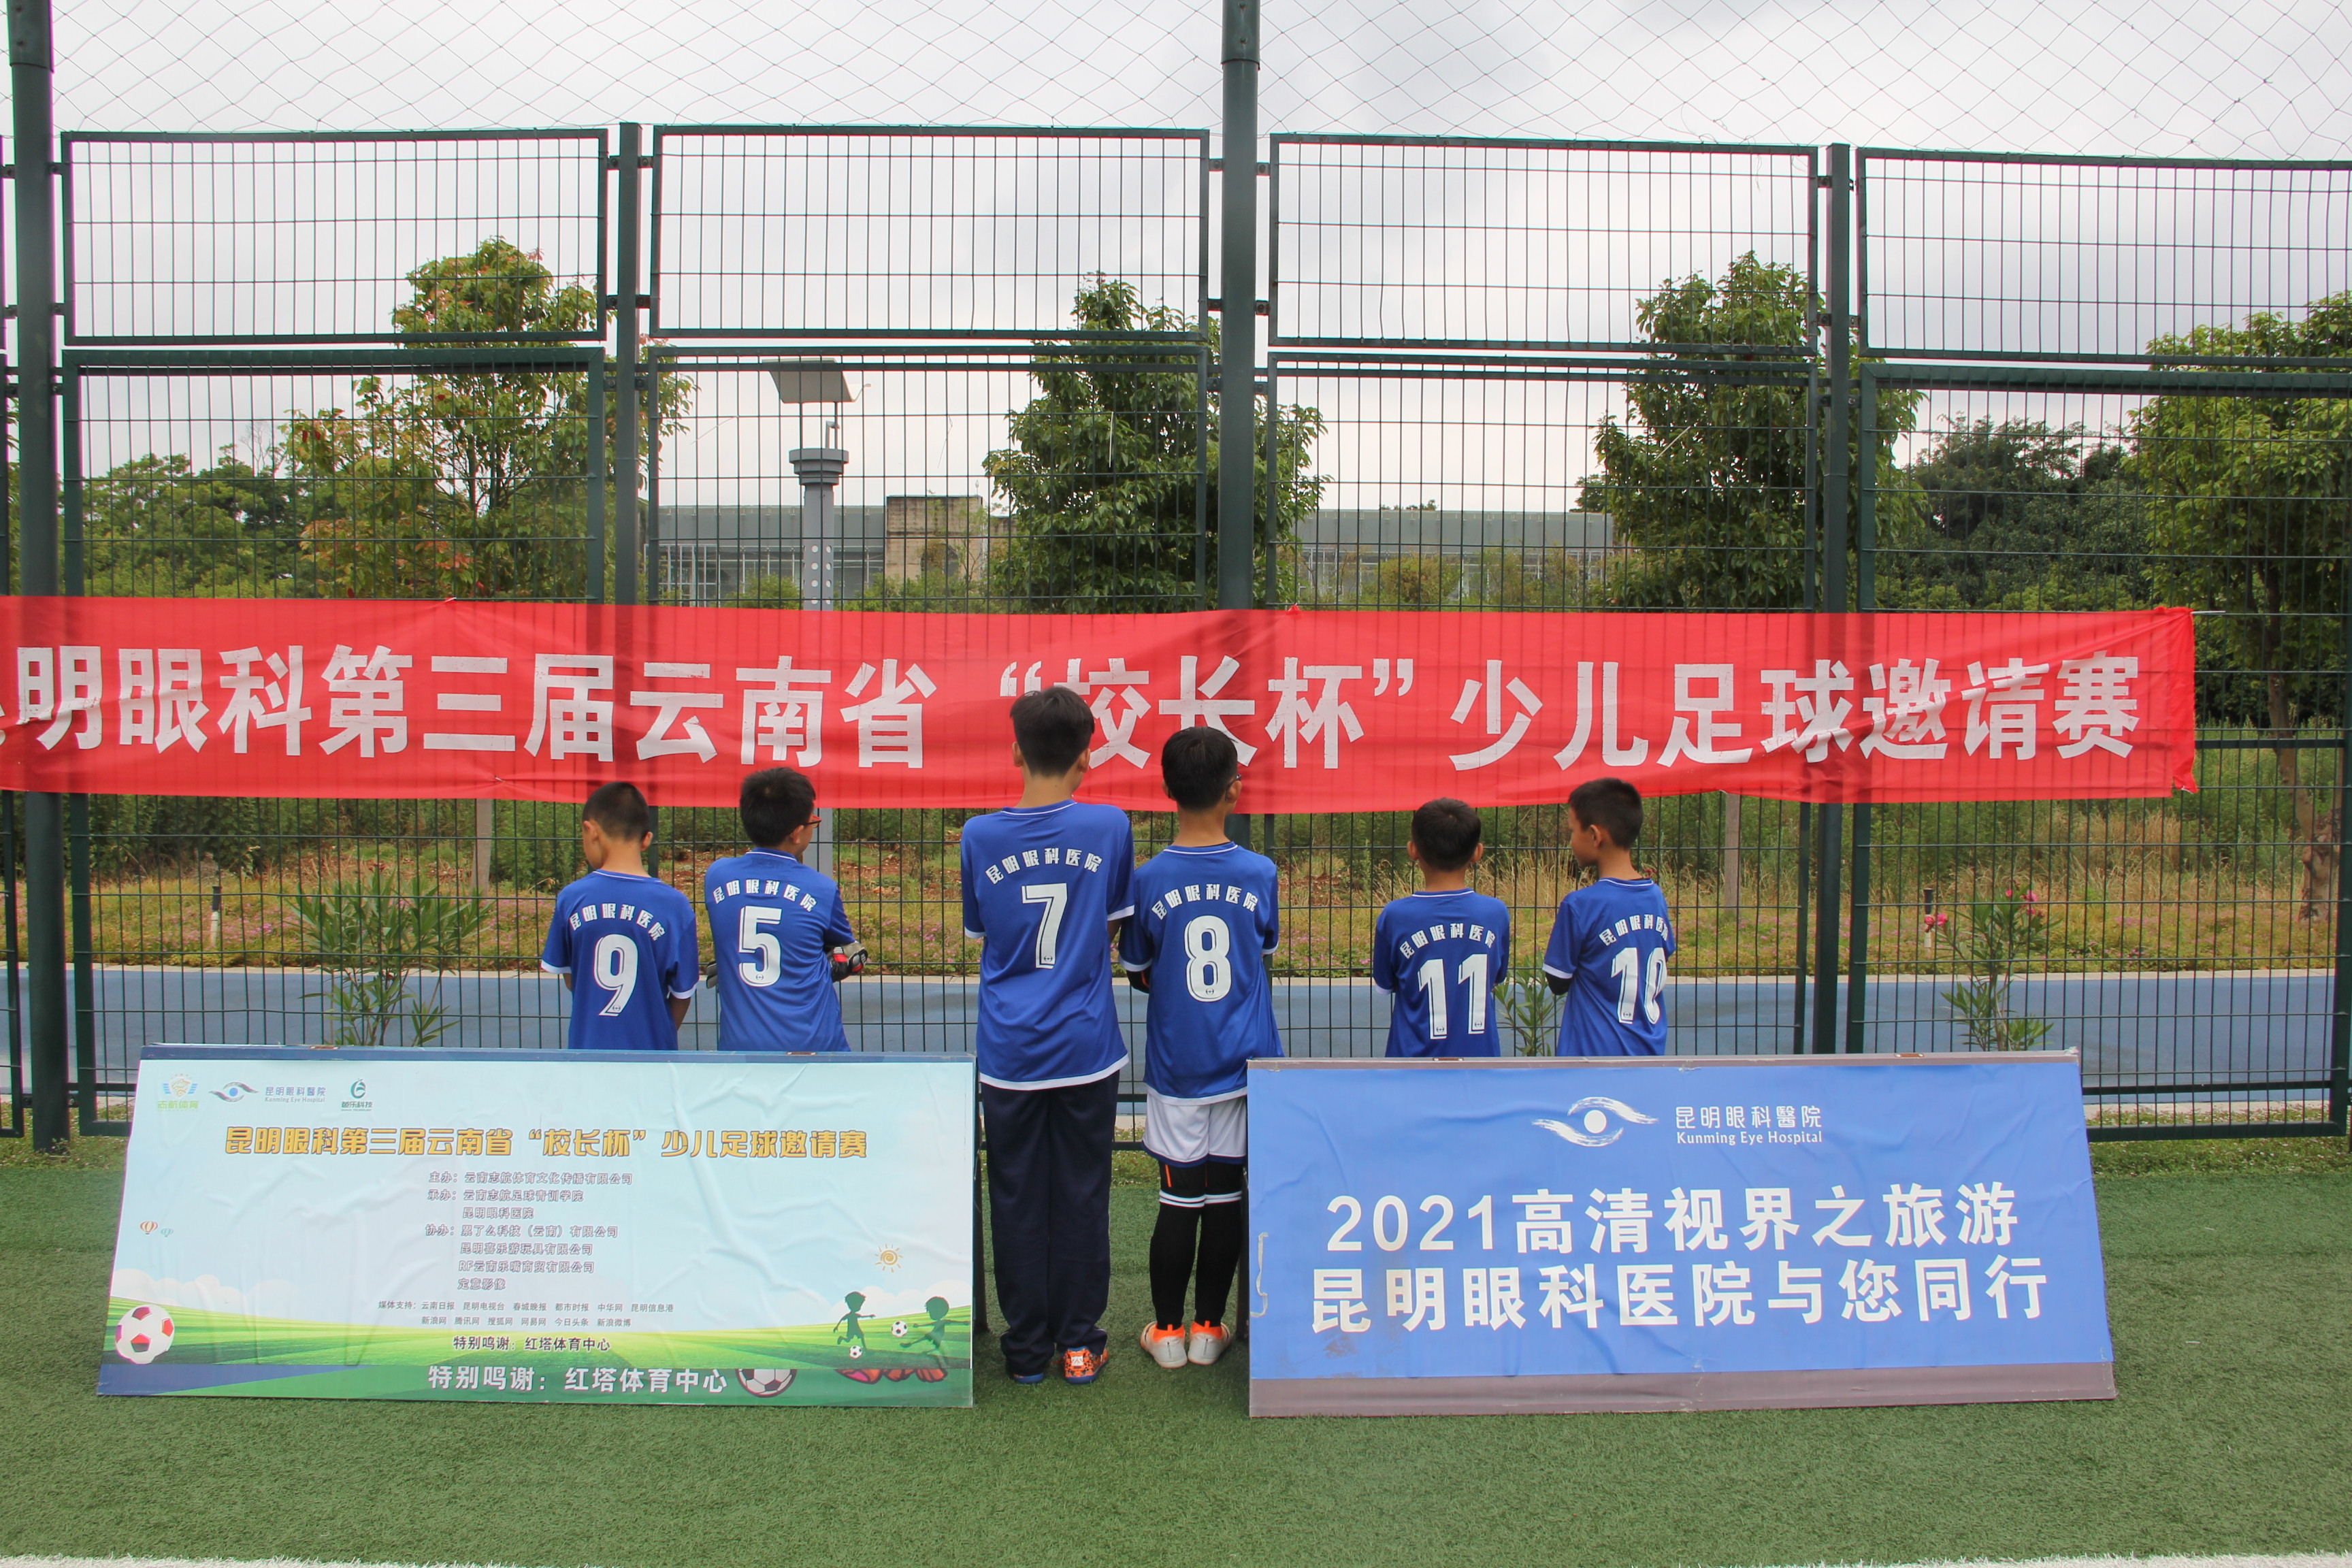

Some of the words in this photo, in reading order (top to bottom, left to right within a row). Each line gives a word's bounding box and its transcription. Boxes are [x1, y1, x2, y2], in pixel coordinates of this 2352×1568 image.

[0, 643, 2140, 771] 明眼科第三届云南省“校长杯”少儿足球邀请赛
[985, 847, 1102, 885] 昆明眼科医院
[713, 879, 817, 913] 昆明眼科医院
[1151, 883, 1259, 921] 昆明眼科医院
[569, 902, 666, 941] 昆明眼科医院
[1022, 883, 1068, 970] 7
[738, 905, 783, 987] 5
[1183, 915, 1232, 1002] 8
[1399, 922, 1496, 960] 昆明眼科医院
[593, 934, 638, 1017] 9
[1610, 947, 1667, 1025] 10
[1417, 953, 1488, 1040] 11
[1675, 1105, 1823, 1129] 昆明眼科醫院
[1676, 1131, 1736, 1146] Kunming
[1740, 1130, 1763, 1145] Eye
[1767, 1130, 1823, 1145] Hospital
[462, 1207, 534, 1220] 昆明眼科医院
[1326, 1180, 2018, 1255] 2021高清视界之旅游
[457, 1277, 506, 1290] 定意影像
[1311, 1255, 2047, 1334] 昆明眼科医院与您同行
[421, 1316, 447, 1325] 新浪网
[454, 1316, 480, 1326] 腾讯网
[487, 1317, 513, 1326] 搜狐网
[521, 1318, 546, 1326] 网易网
[555, 1318, 589, 1327] 今日头条
[597, 1318, 632, 1327] 新浪微博
[463, 1301, 506, 1311] 昆明电视台
[512, 1302, 547, 1311] 春城晚报
[555, 1303, 589, 1312] 都市时报
[598, 1303, 623, 1312] 中华网
[631, 1303, 674, 1313] 昆明信息港
